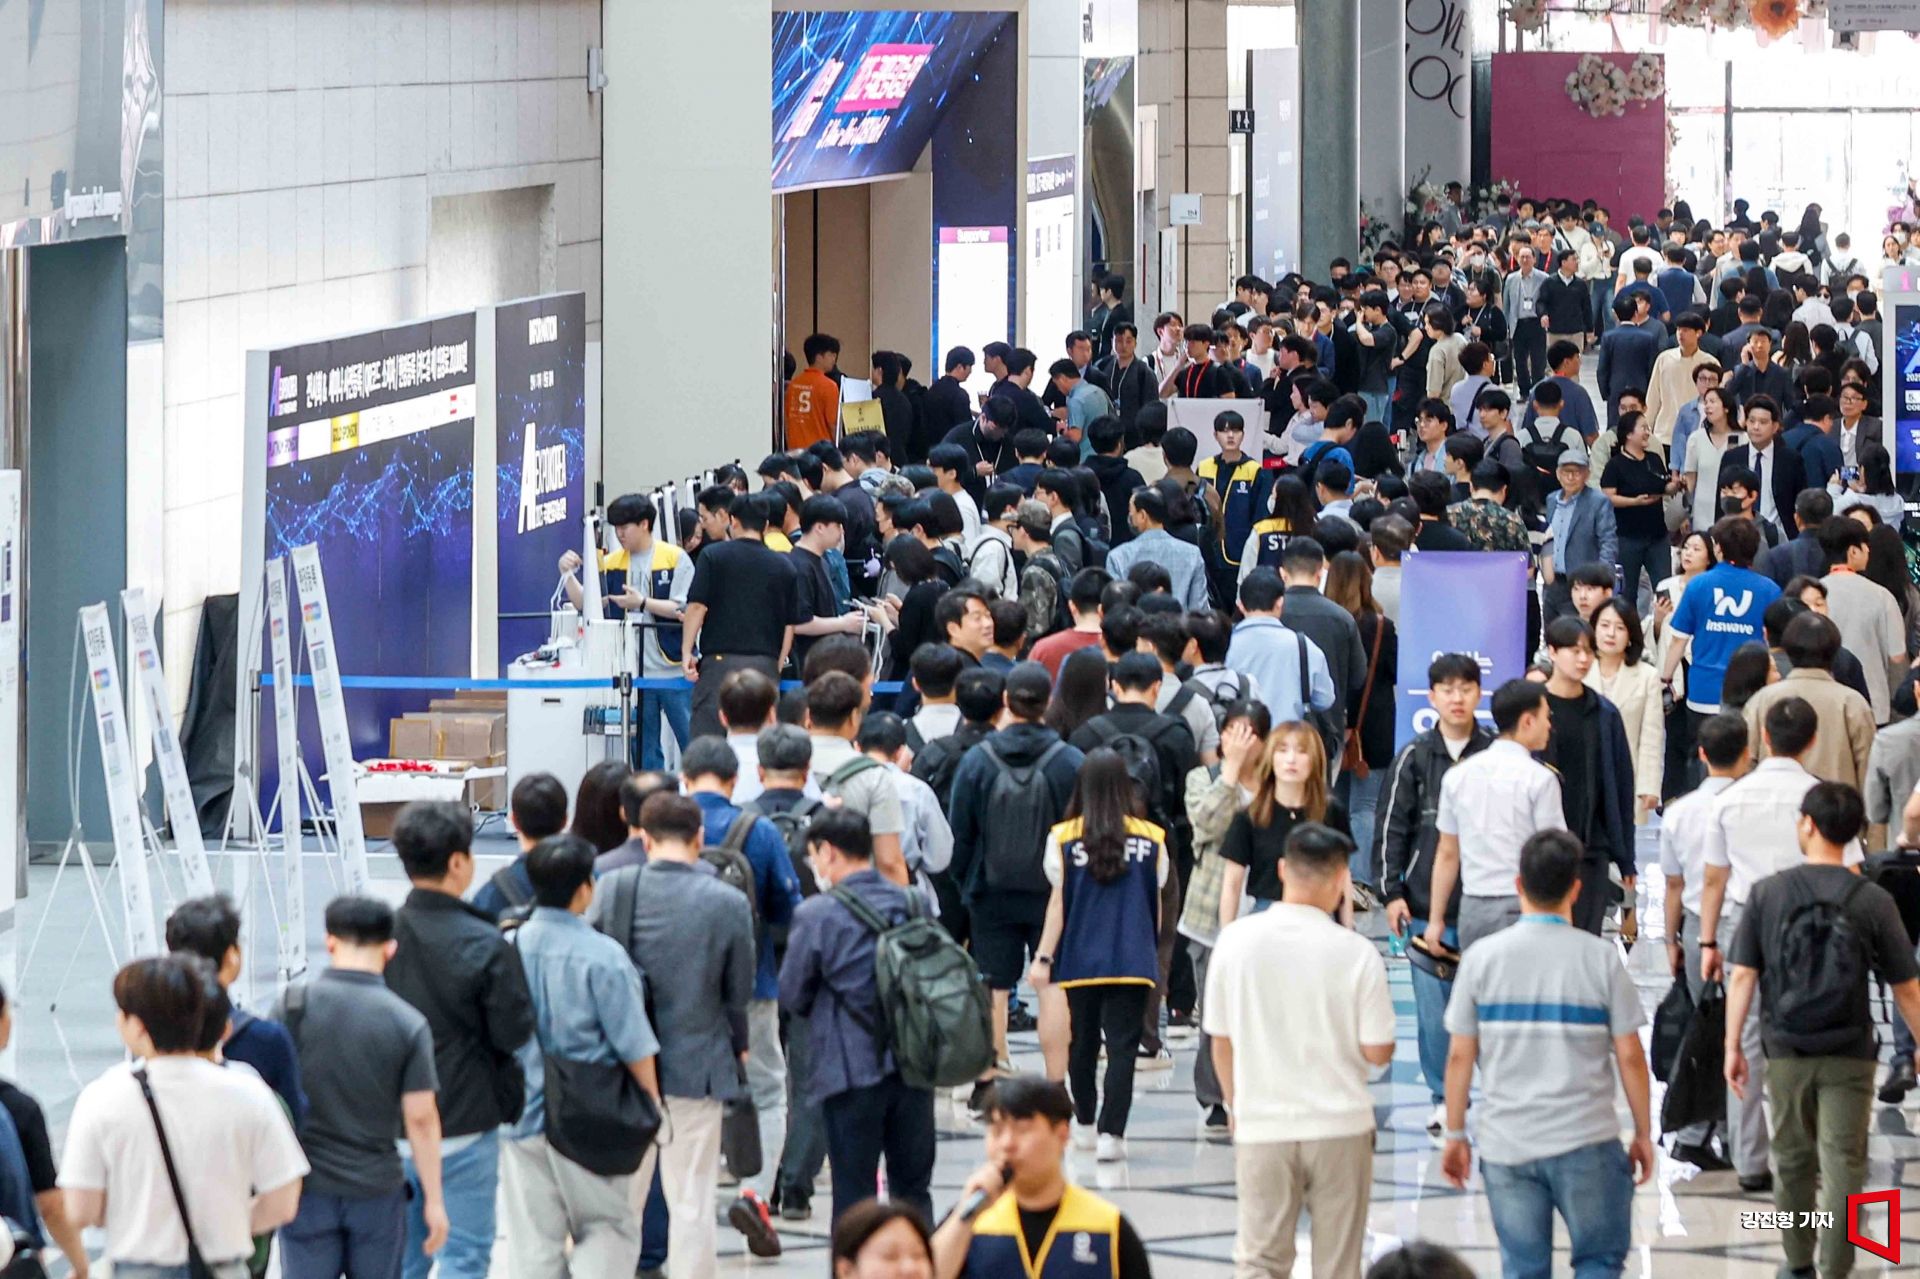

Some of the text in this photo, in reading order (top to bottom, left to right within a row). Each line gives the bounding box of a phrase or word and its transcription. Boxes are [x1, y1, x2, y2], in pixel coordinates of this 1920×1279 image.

[1268, 534, 1290, 551] ST
[1705, 618, 1754, 635] inswave
[1071, 837, 1152, 867] SFF
